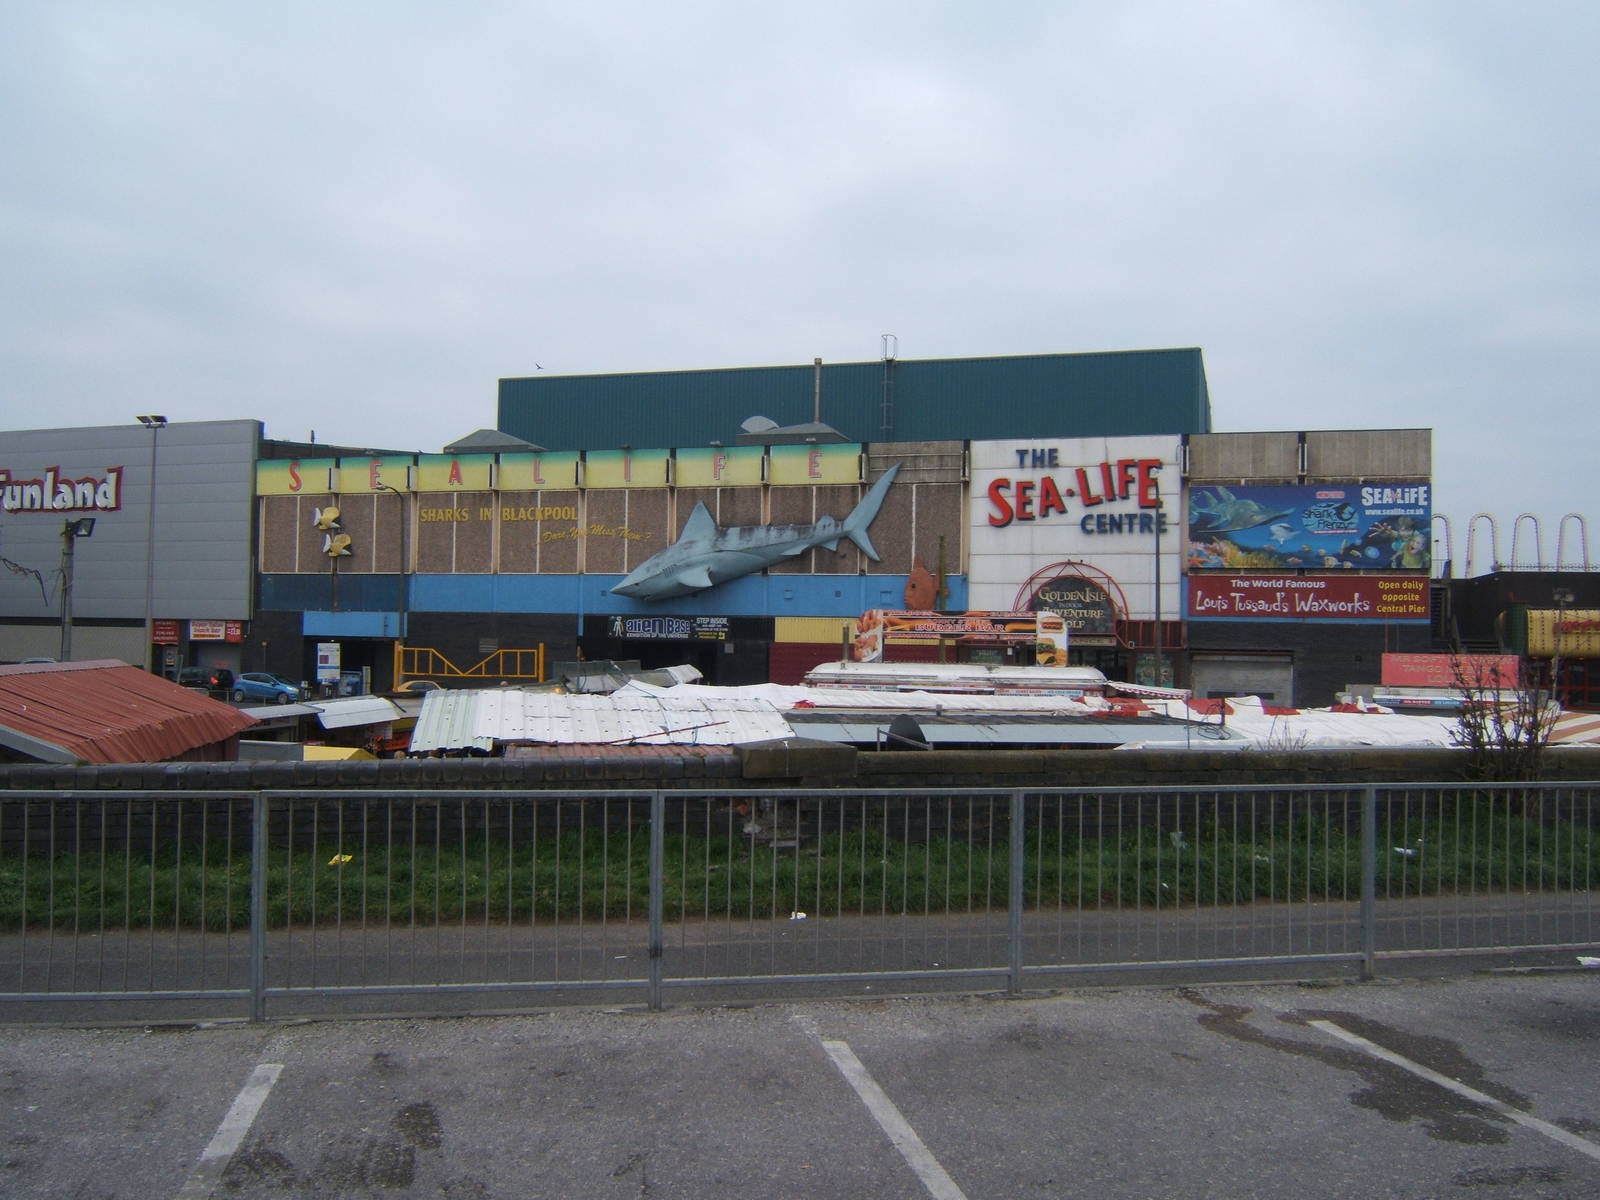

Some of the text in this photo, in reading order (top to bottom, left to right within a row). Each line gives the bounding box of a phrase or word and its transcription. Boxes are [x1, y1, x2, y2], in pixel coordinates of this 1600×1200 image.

[1016, 448, 1060, 469] THE
[420, 506, 578, 522] SHARKS IN BLACKPOOL
[1080, 512, 1169, 535] CENTRE
[1231, 579, 1326, 589] The World Famous
[1378, 580, 1424, 591] Open daily
[1039, 587, 1084, 602] GOLDEN
[1382, 592, 1420, 602] opposite
[1196, 591, 1370, 614] Louis Tussaud's Waxworks
[1377, 604, 1426, 614] Central Pier
[696, 617, 710, 625] STEP
[1066, 620, 1086, 629] OLF
